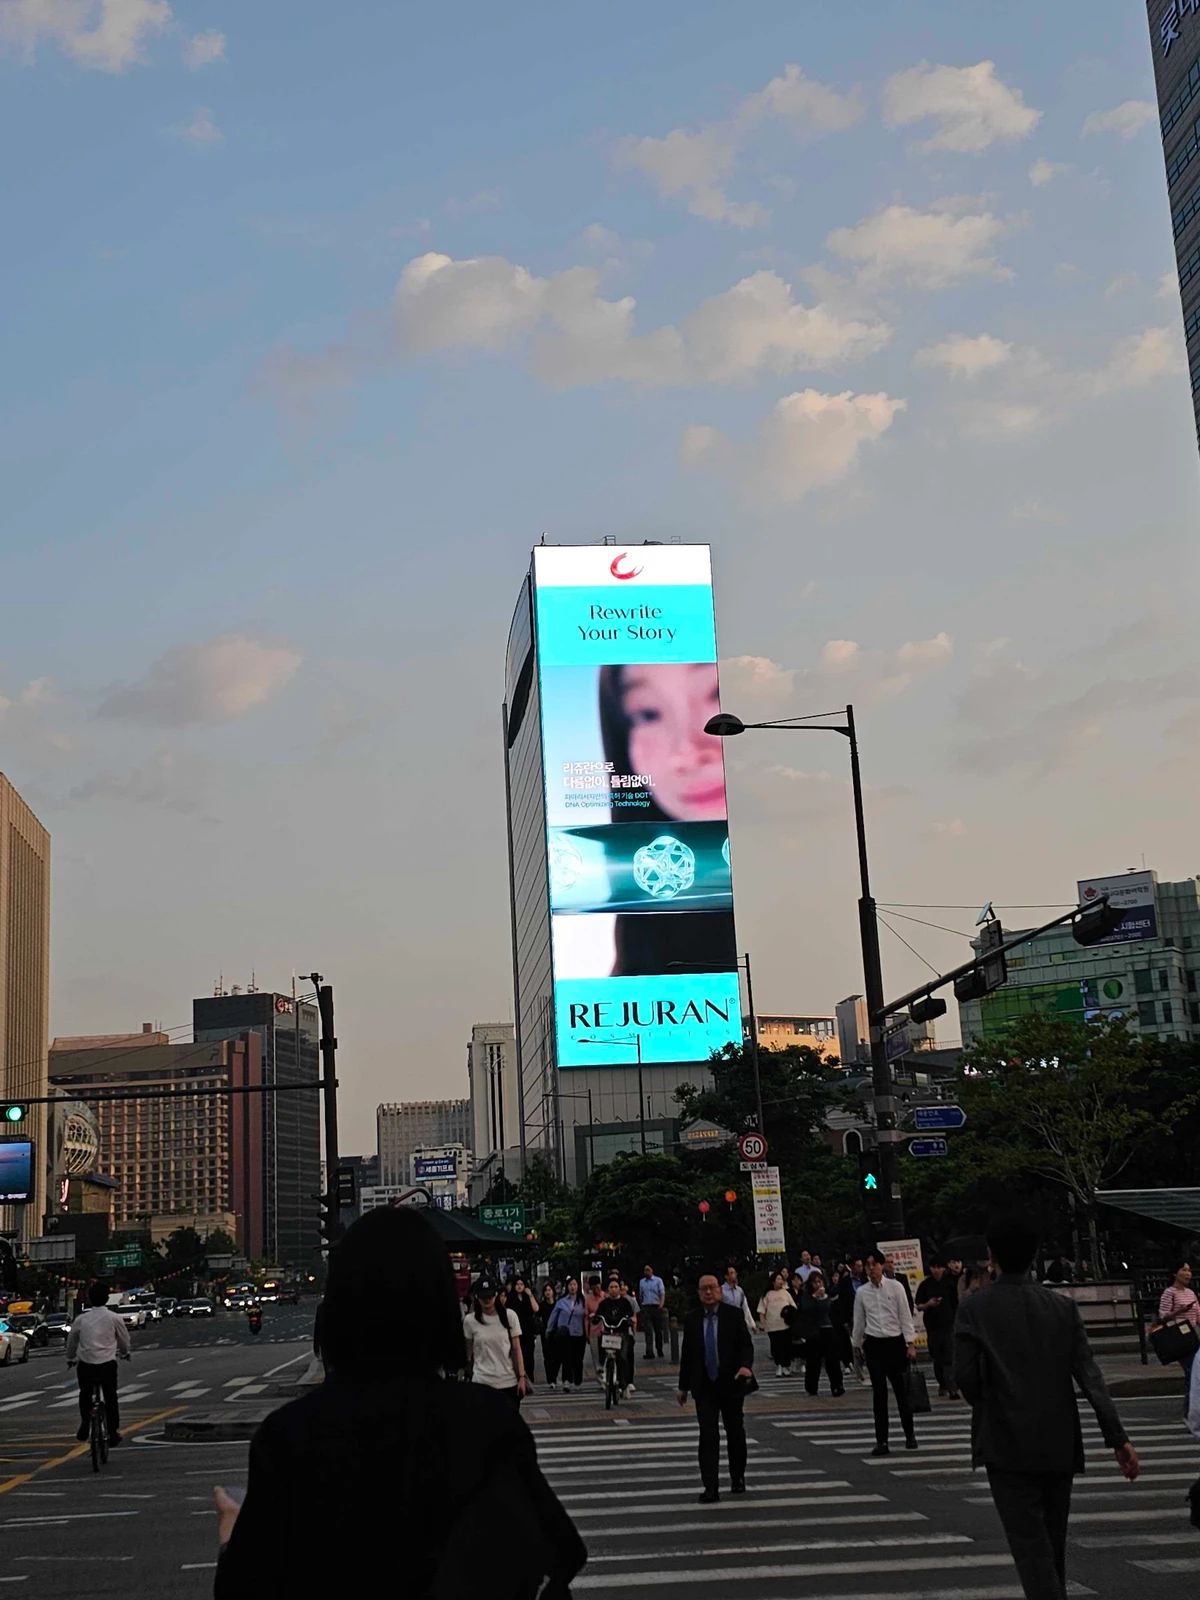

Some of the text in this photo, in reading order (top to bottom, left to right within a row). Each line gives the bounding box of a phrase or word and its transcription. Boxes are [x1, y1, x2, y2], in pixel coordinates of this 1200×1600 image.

[590, 604, 662, 619] Rewrite
[577, 625, 676, 643] Your Story
[563, 761, 615, 774] 리쥬란으로
[580, 800, 613, 808] Optimizing
[614, 800, 651, 808] Technology
[744, 1140, 761, 1155] 50
[483, 1207, 519, 1218] 종로1가
